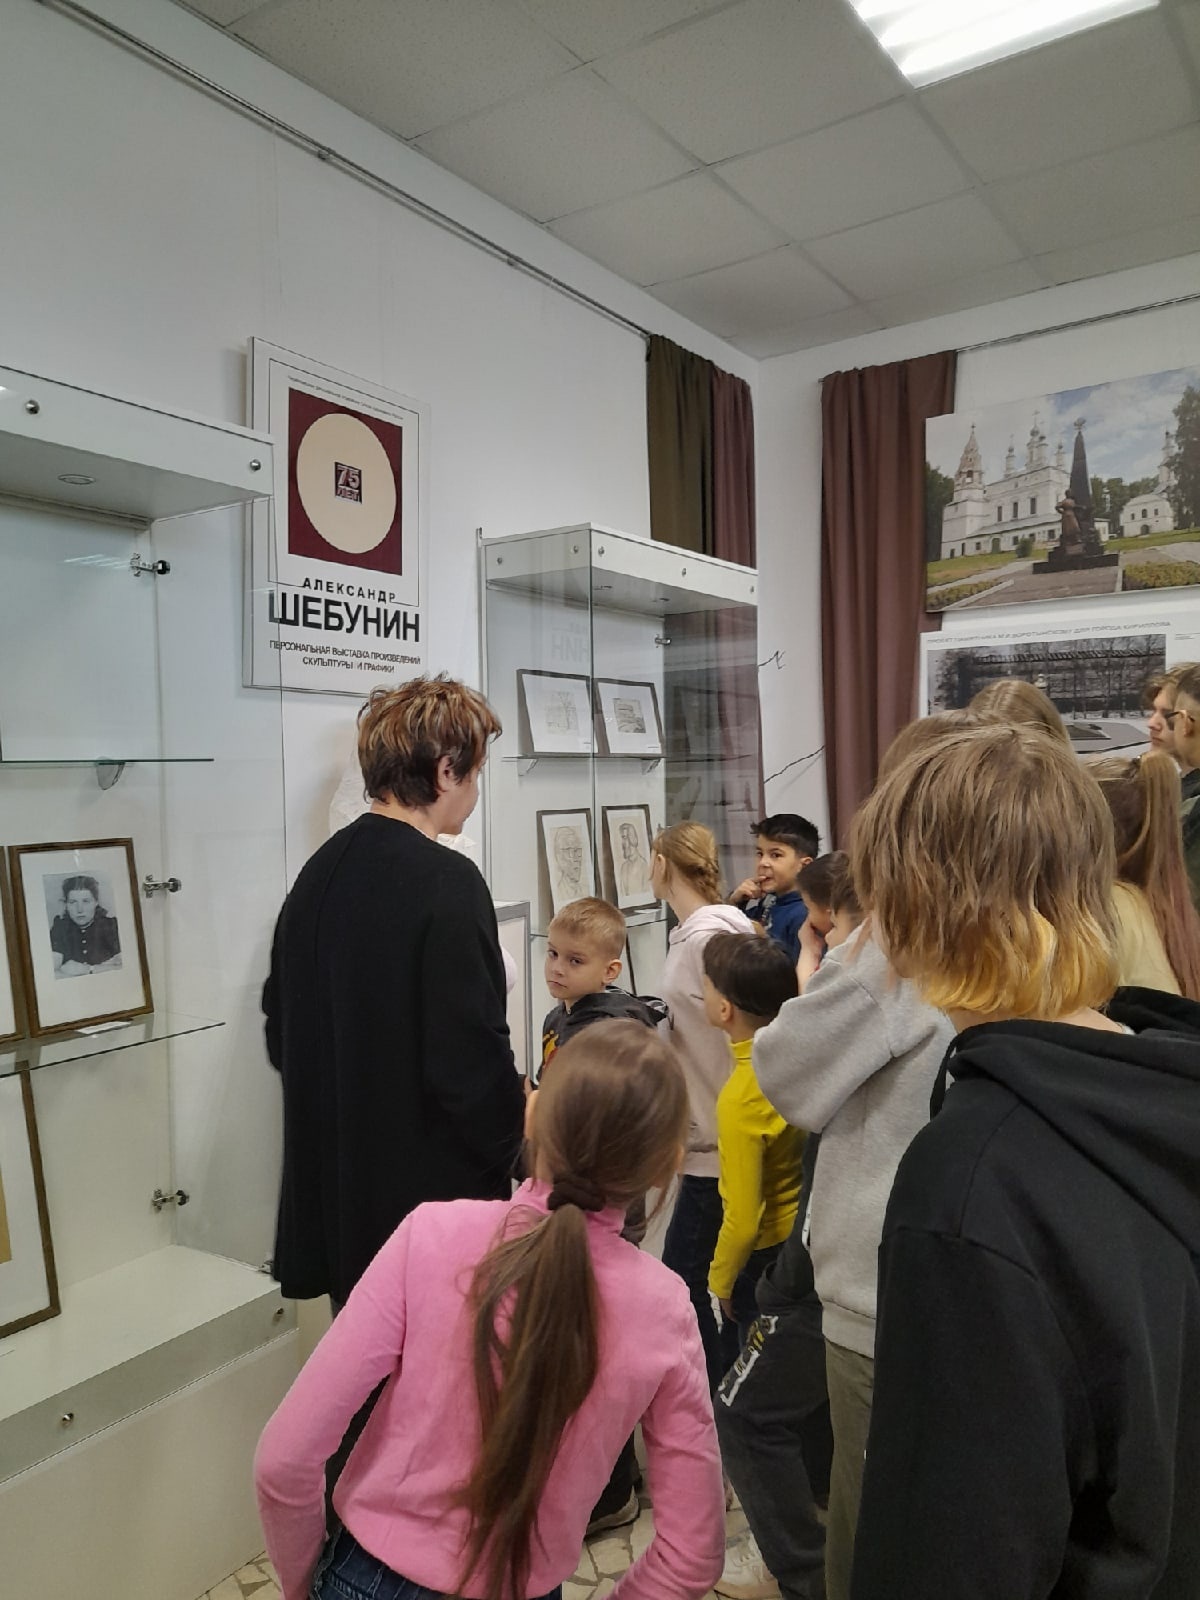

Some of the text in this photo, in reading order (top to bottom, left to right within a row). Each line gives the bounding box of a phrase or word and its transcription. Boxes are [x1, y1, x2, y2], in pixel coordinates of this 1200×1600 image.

[337, 464, 360, 489] 75
[303, 577, 396, 603] АЛЕКСАНДР
[269, 590, 420, 643] ШЕБУНИН
[269, 640, 421, 665] ПЕРСОНАЛЬНАЯ ВЫСТАВКА ПРОИЗВЕДЕНИЙ
[302, 656, 395, 673] СКУЛЬПТУРЫ И ГРАФИКИ
